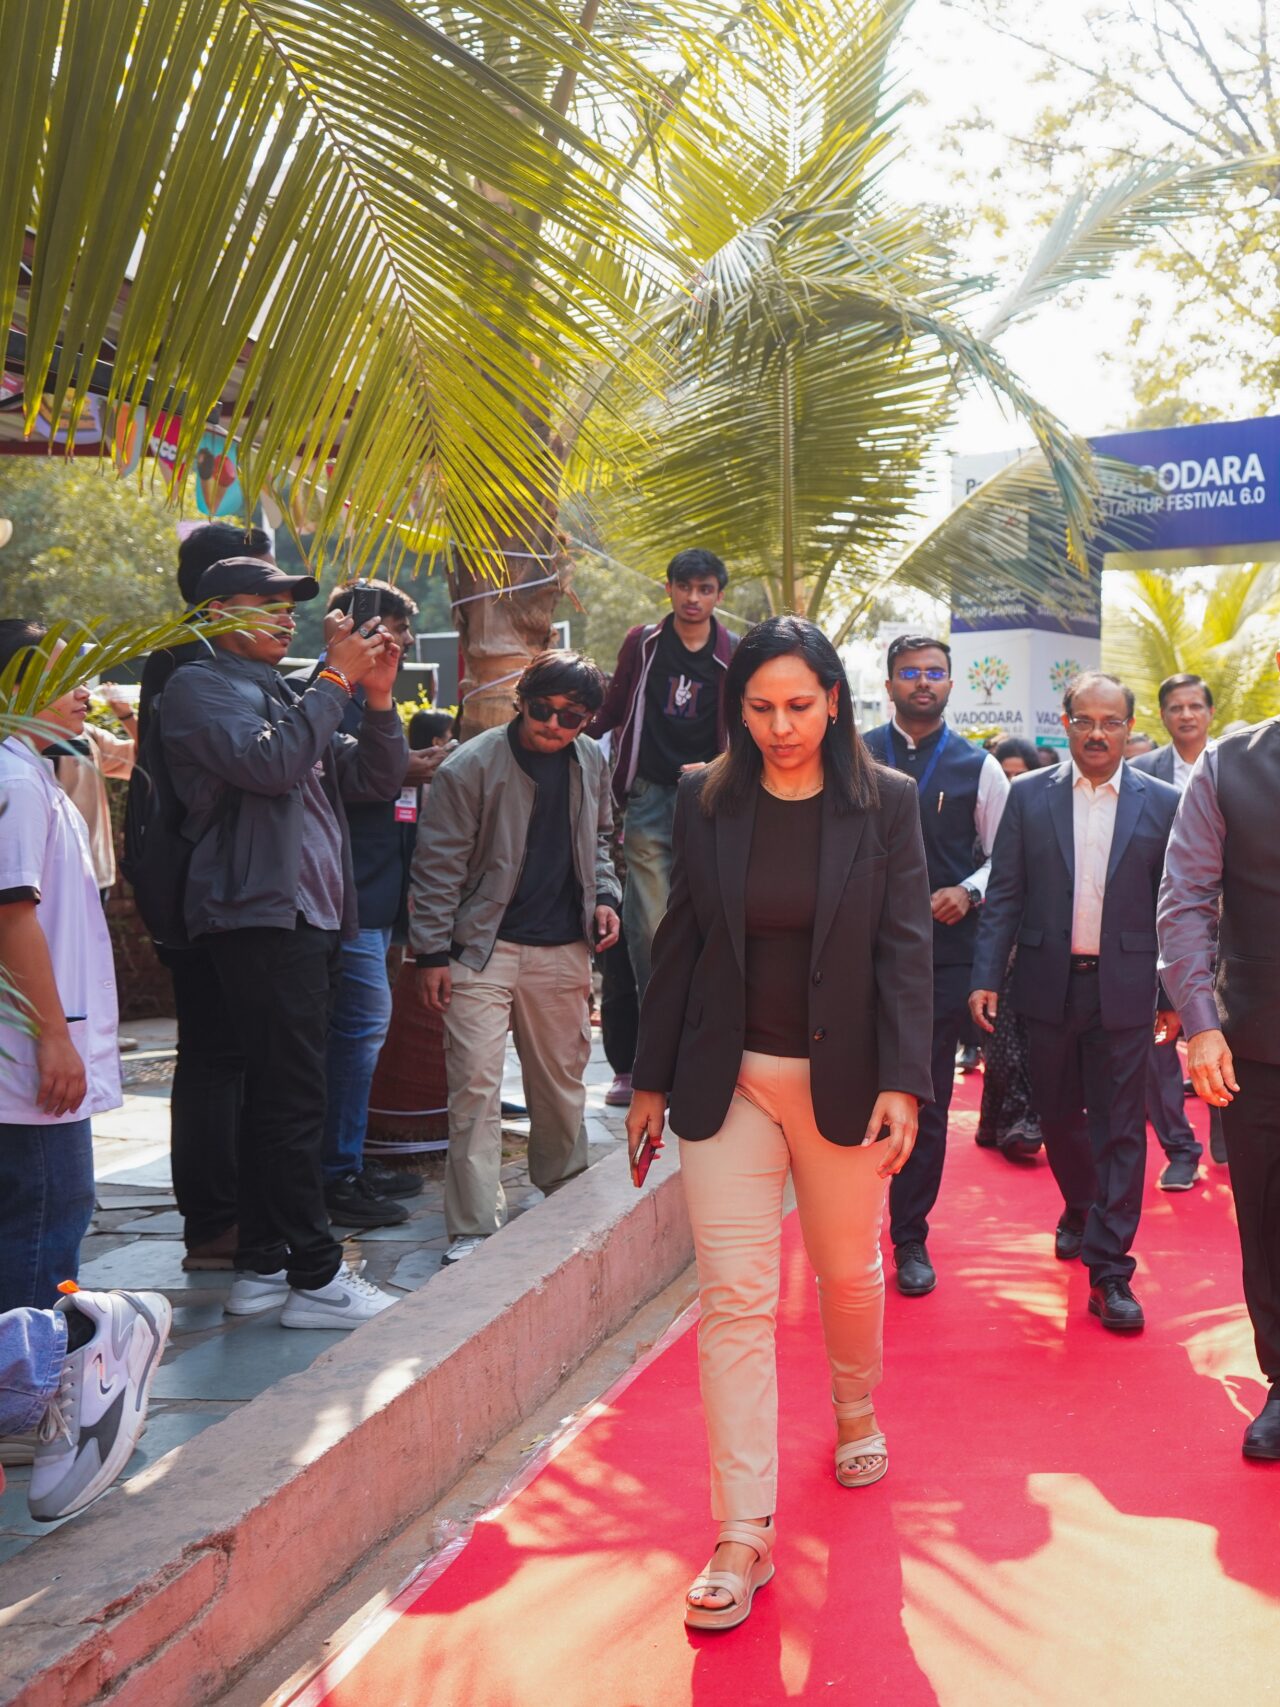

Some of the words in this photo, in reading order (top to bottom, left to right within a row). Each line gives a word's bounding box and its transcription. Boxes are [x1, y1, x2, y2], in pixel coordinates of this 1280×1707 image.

[1167, 489, 1236, 511] FESTIVAL
[1239, 481, 1265, 505] 6.0
[953, 710, 1024, 724] VADODARA
